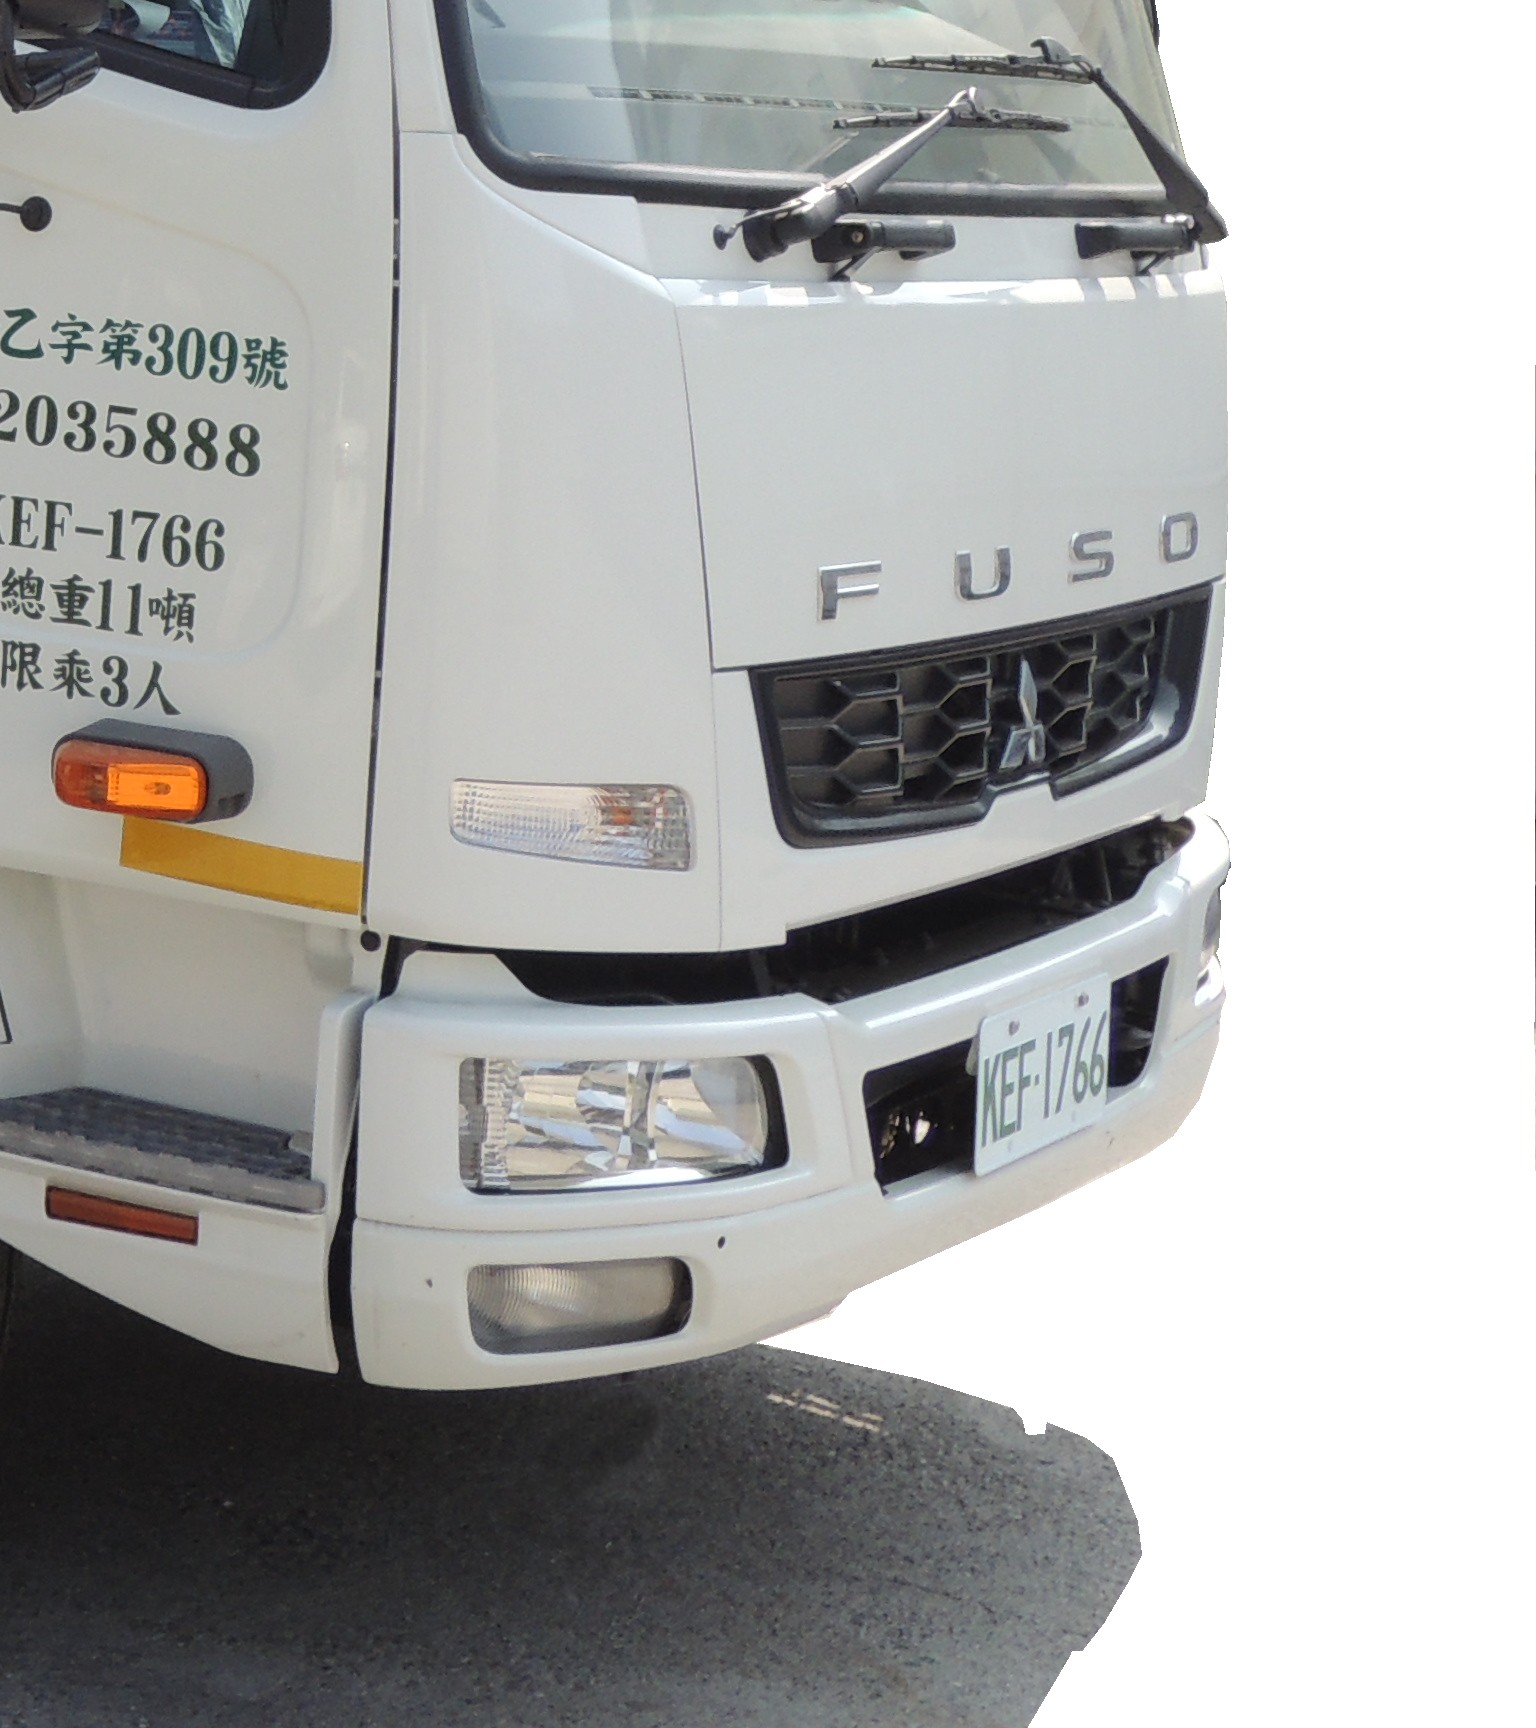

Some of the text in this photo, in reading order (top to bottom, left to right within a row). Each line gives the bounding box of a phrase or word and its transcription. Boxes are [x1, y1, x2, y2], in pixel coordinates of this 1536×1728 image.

[0, 566, 197, 644] 總重11噸
[818, 511, 1199, 622] FUSO
[0, 639, 181, 716] 限乘3人
